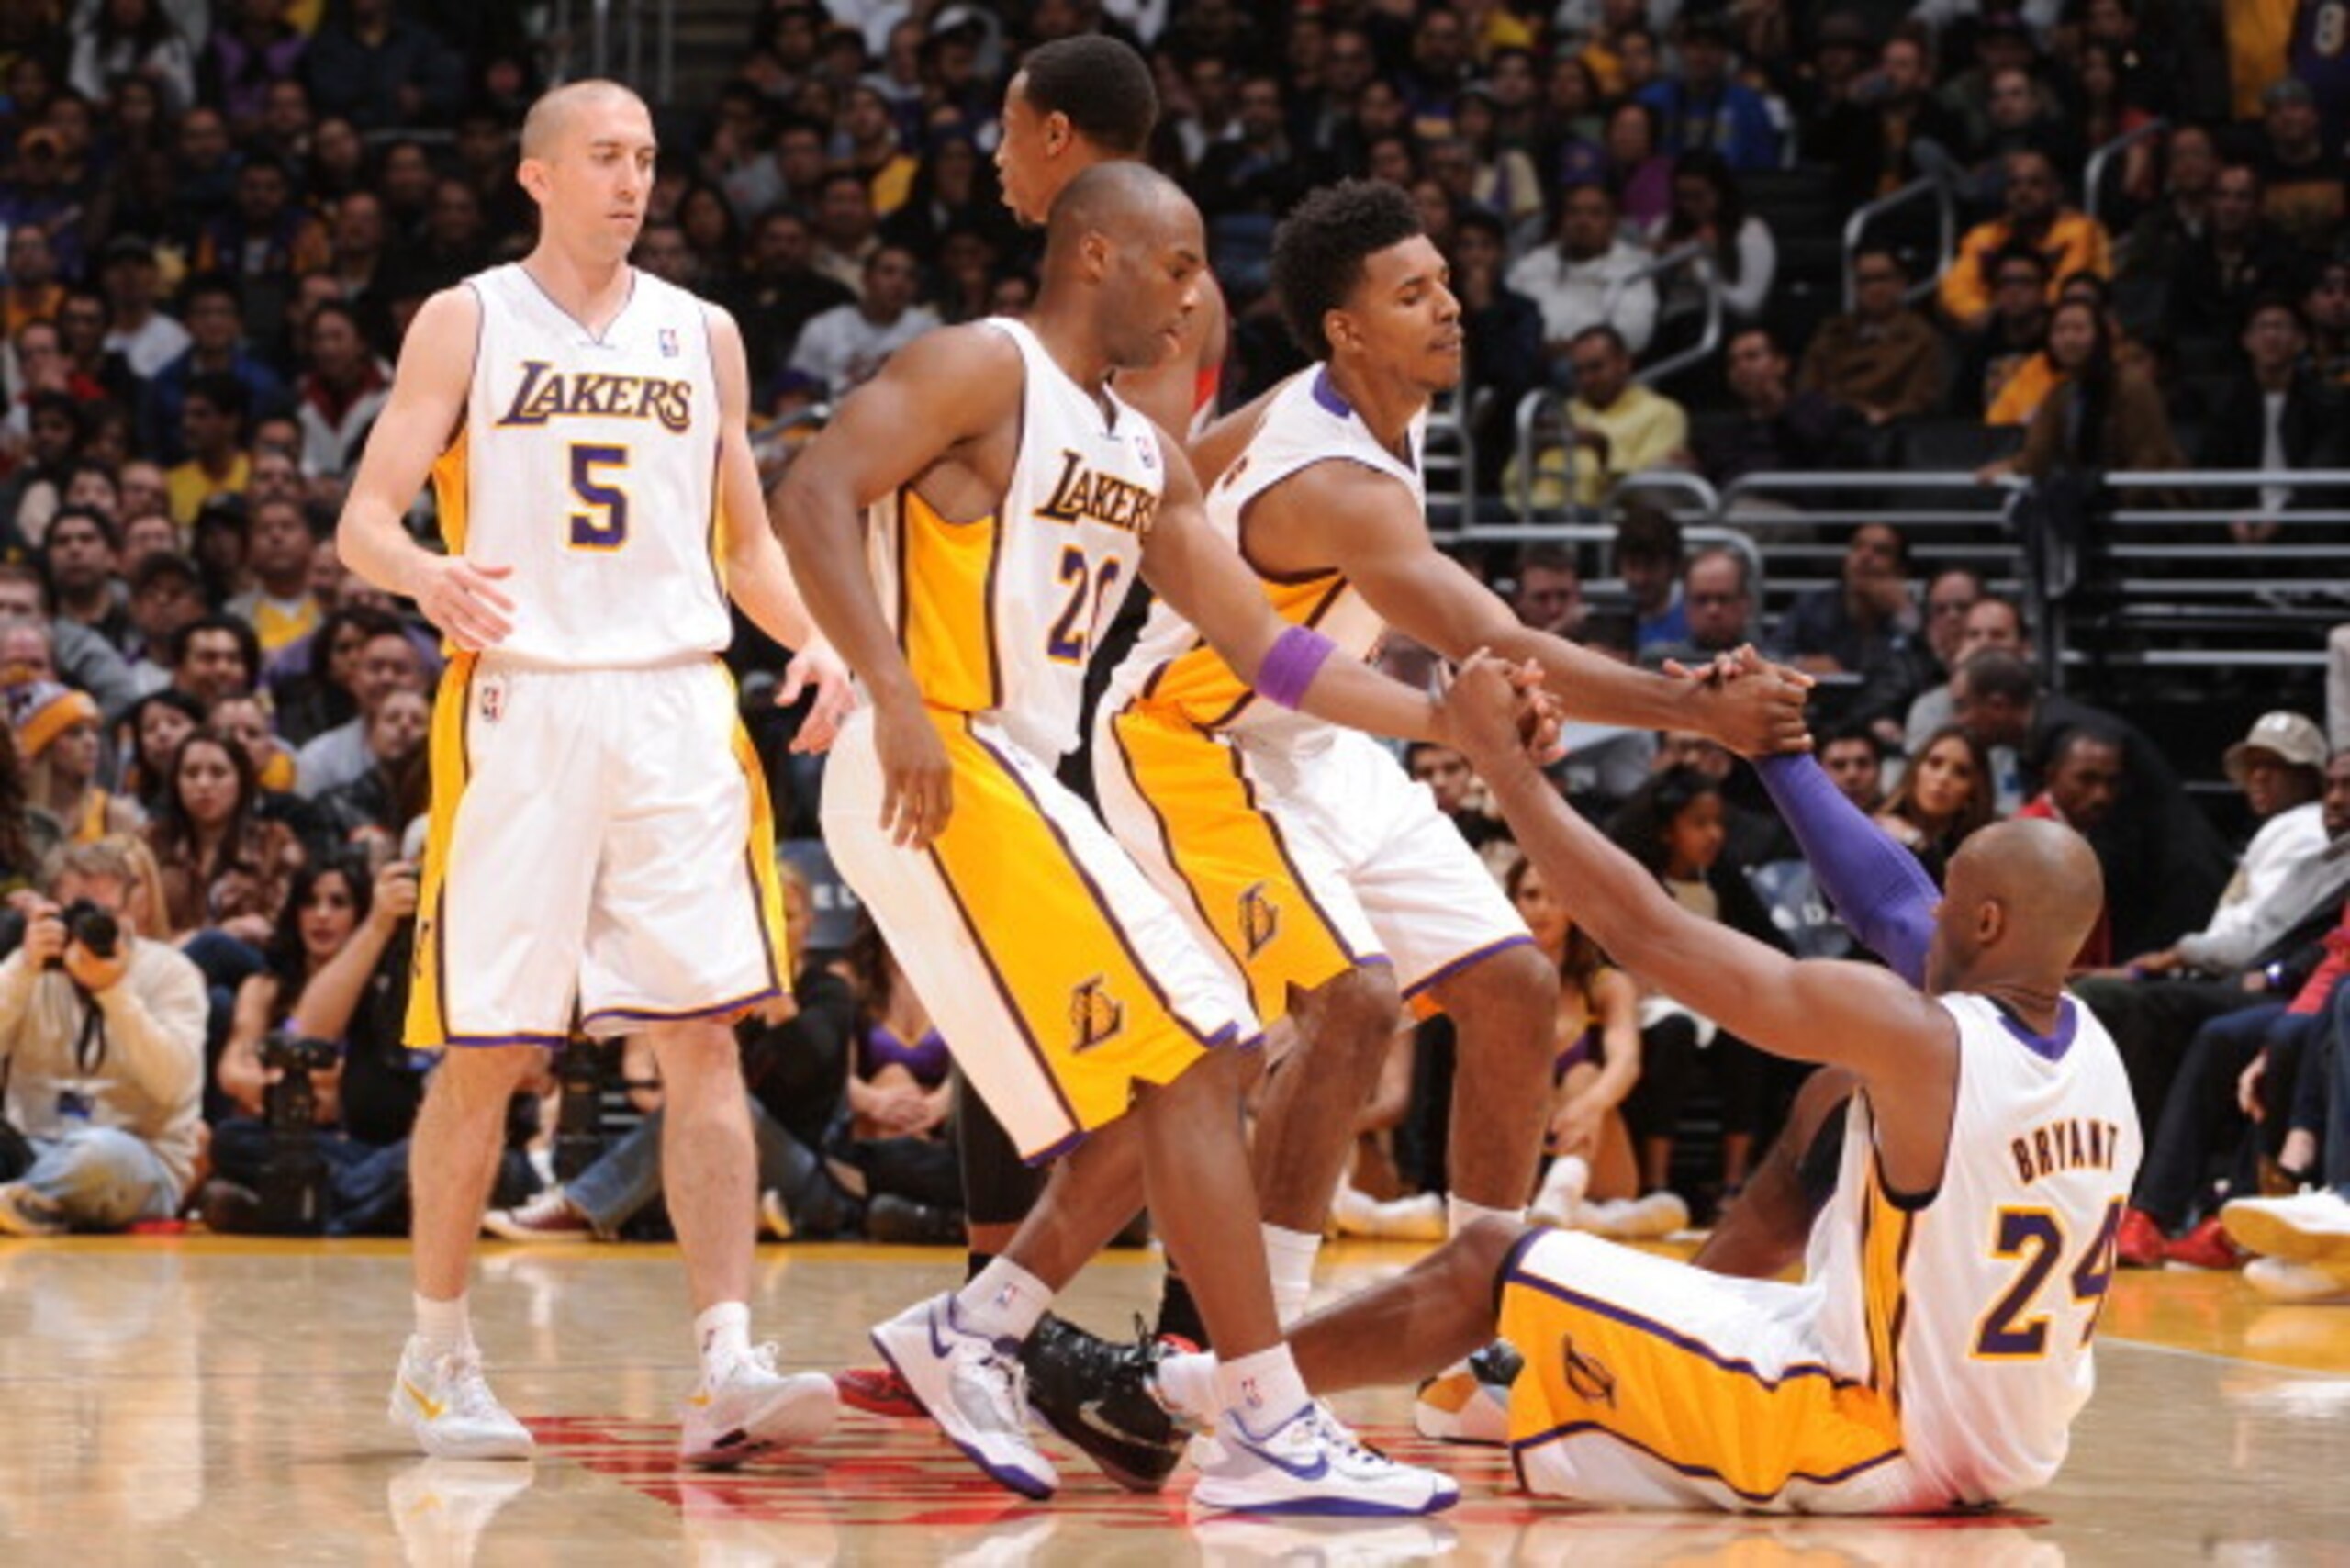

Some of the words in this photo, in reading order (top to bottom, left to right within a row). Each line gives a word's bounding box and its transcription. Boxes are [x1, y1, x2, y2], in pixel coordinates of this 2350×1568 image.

[493, 360, 691, 434] LAKERS
[568, 441, 630, 552] 5
[2010, 1118, 2118, 1185] BRYANT
[1969, 1194, 2125, 1360] 24
